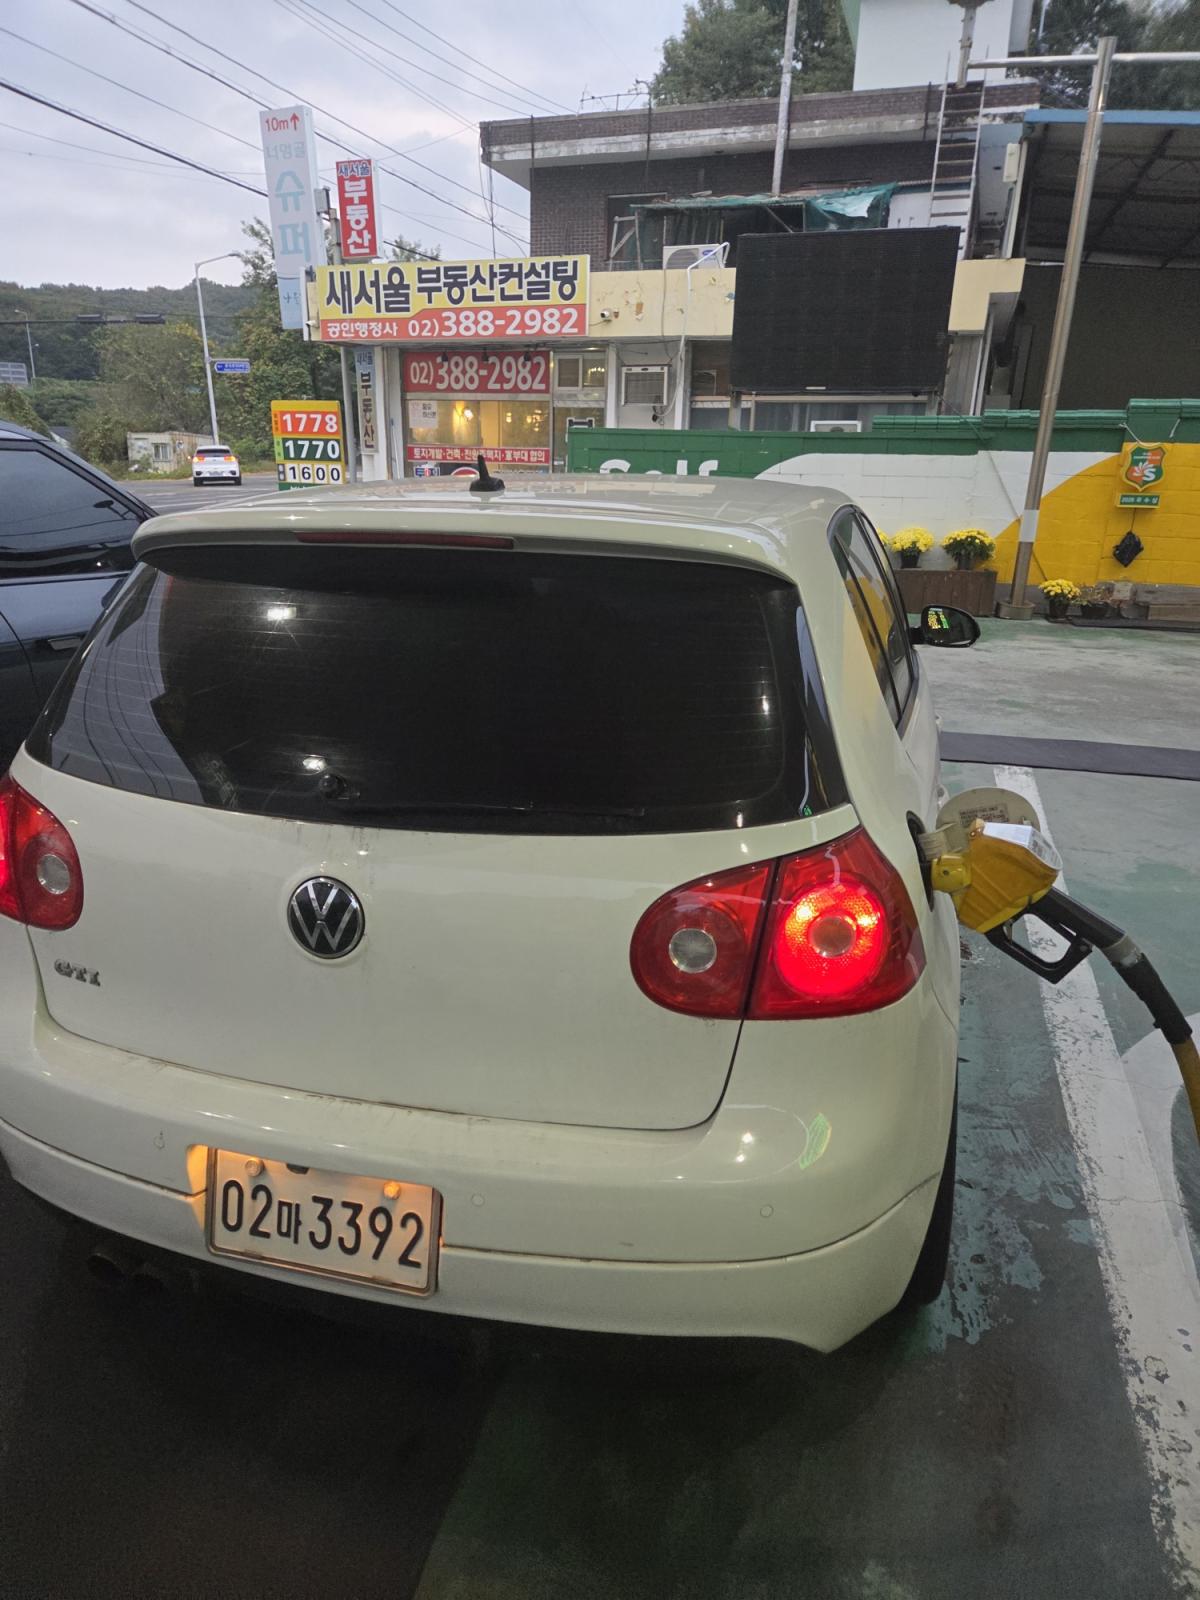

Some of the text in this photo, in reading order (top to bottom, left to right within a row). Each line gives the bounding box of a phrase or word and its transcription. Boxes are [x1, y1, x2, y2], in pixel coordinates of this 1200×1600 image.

[265, 117, 289, 132] 10m
[338, 163, 370, 178] 새서울
[274, 170, 312, 262] 슈퍼
[344, 179, 371, 255] 부동산
[326, 260, 579, 314] 새서울 부동산컨설팅
[327, 321, 398, 338] 공인행정사
[407, 307, 579, 337] 02)388-2982
[282, 413, 338, 433] 1778
[285, 440, 340, 459] 1770
[288, 466, 341, 482] 1600
[54, 958, 101, 987] GTI
[221, 1179, 424, 1269] 02마3392
